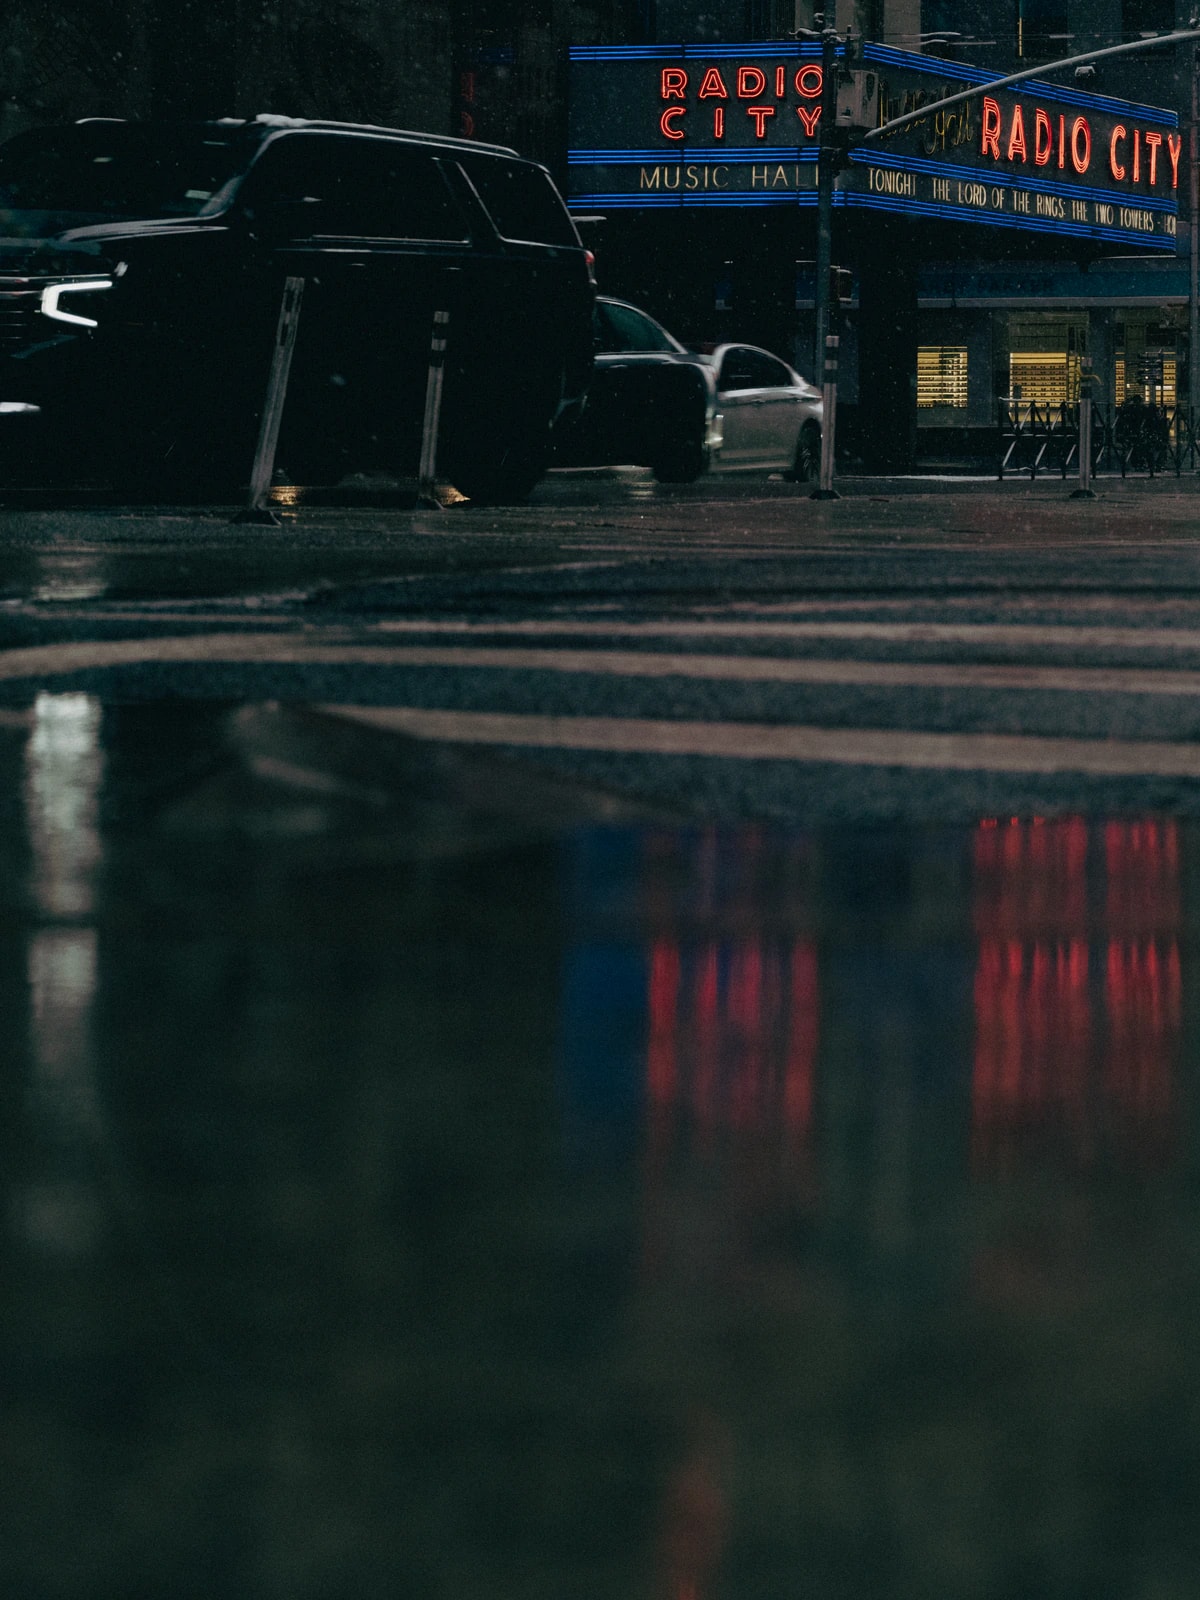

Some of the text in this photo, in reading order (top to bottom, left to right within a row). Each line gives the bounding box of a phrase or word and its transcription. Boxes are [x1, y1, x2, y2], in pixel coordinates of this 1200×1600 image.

[661, 63, 823, 99] RADIO
[660, 105, 822, 139] CITY
[981, 95, 1183, 190] RADIO CITY
[639, 164, 729, 190] MUSIC
[868, 167, 918, 197] TONIGHT
[932, 177, 951, 201] THE
[958, 182, 987, 207] LORD
[991, 187, 1006, 209] OF
[1013, 190, 1031, 213] THE
[1072, 199, 1089, 222] THE
[1095, 203, 1115, 225] TWO
[1119, 207, 1155, 232] TOWERS
